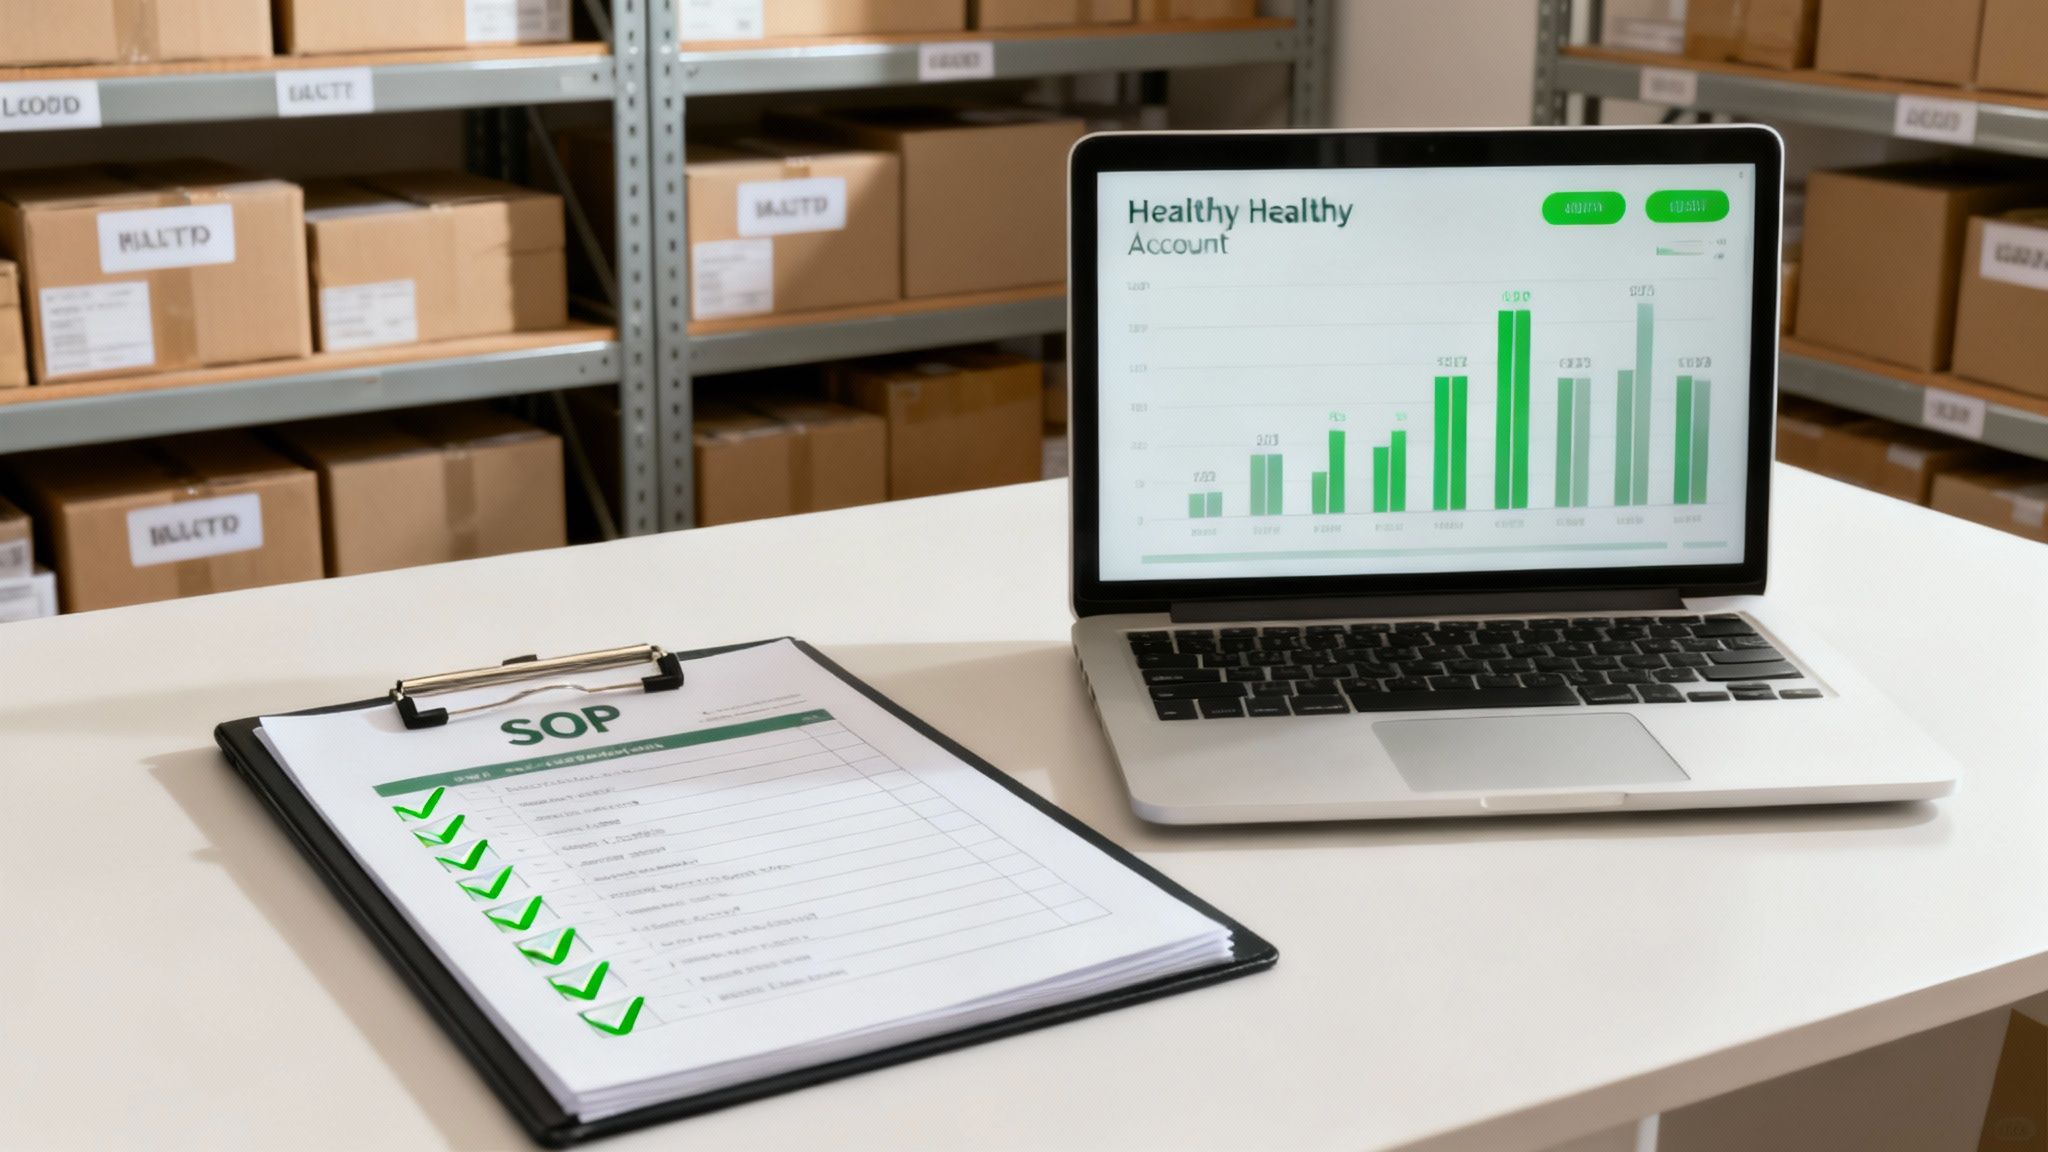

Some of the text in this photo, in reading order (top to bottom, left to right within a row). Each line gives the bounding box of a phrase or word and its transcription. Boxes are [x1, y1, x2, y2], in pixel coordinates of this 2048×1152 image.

[1128, 196, 1354, 230] Healthy Healthy
[1127, 230, 1230, 256] Account
[500, 704, 621, 746] SOP
